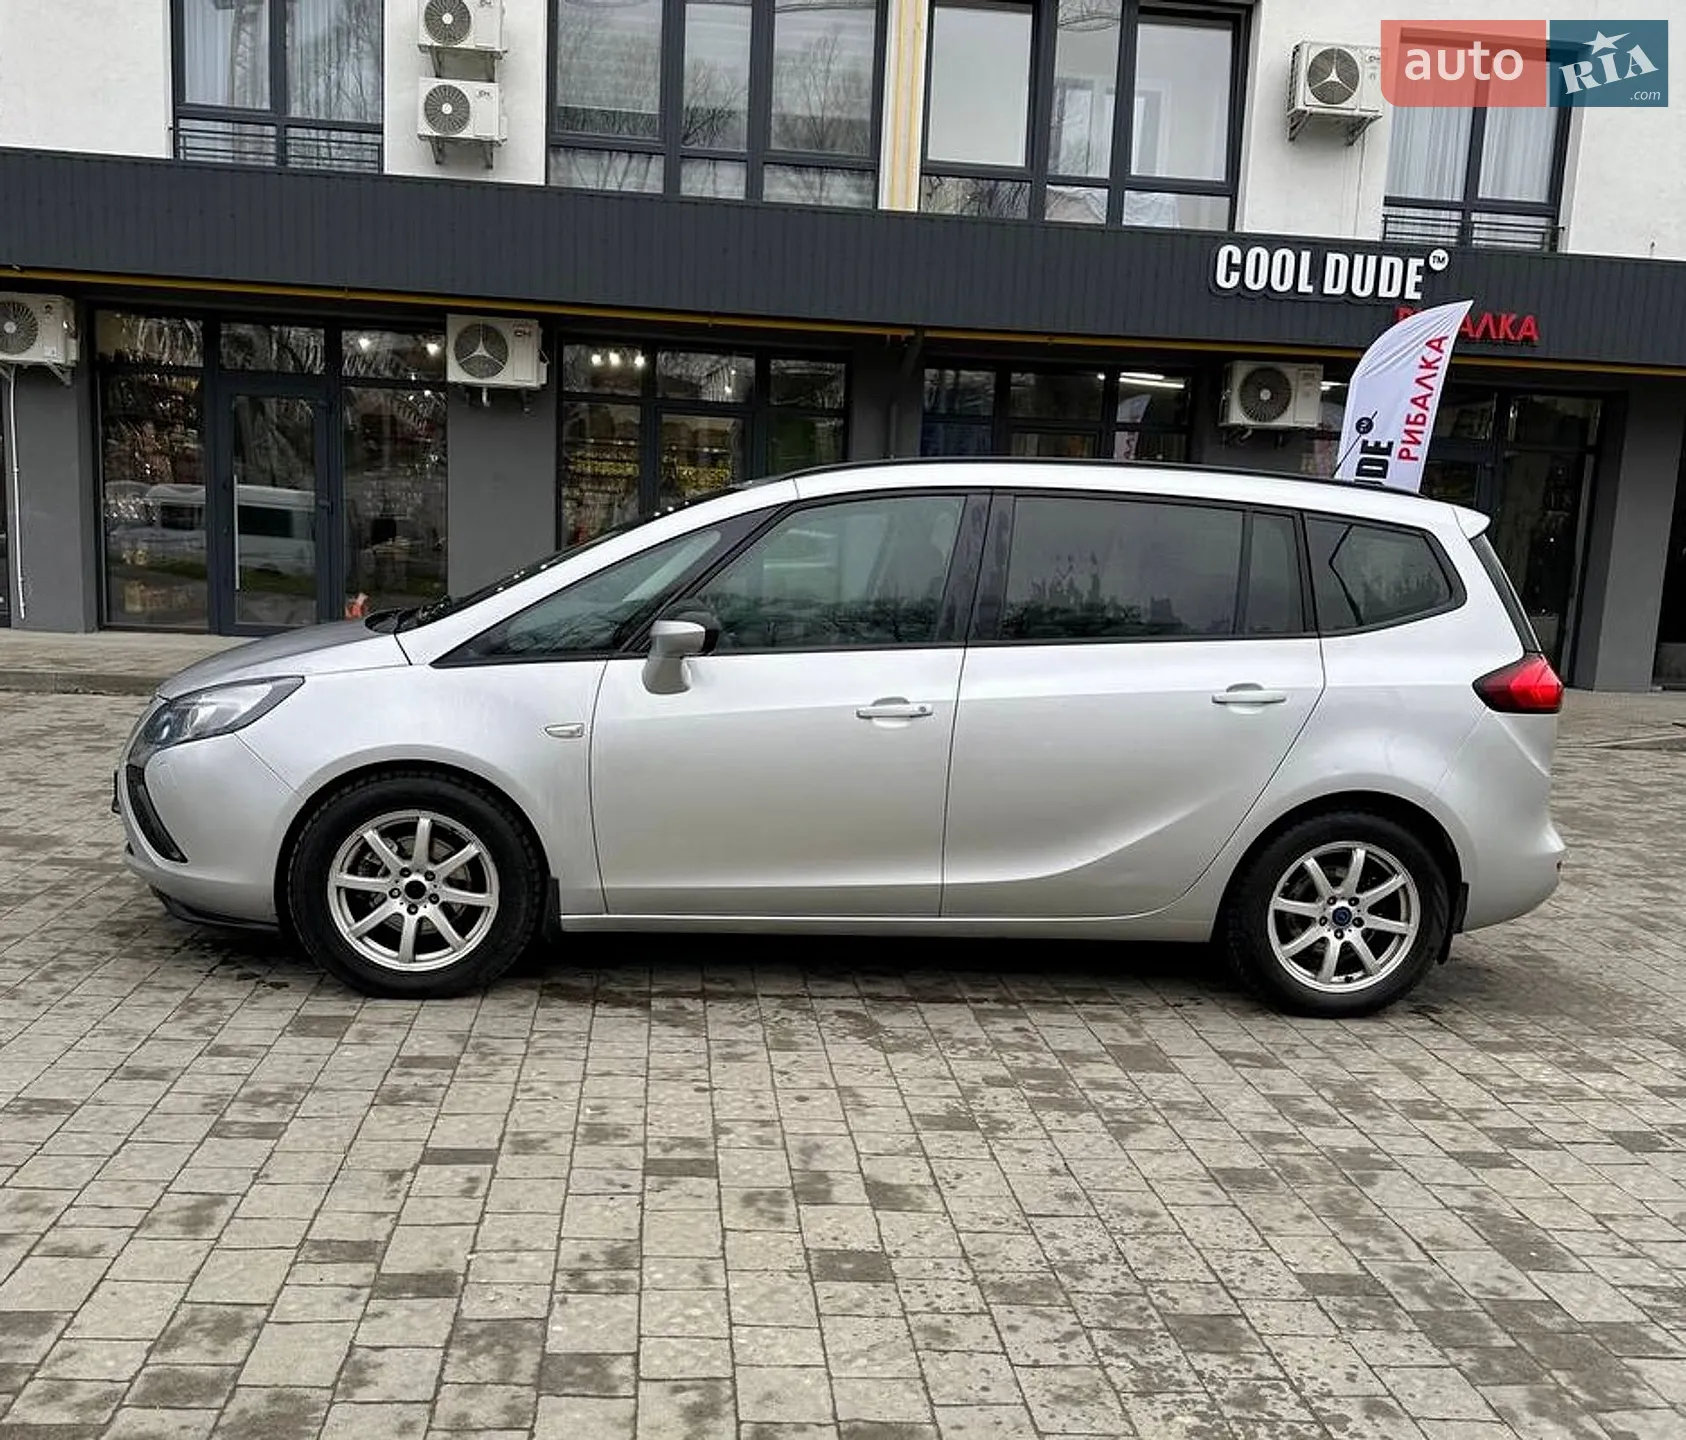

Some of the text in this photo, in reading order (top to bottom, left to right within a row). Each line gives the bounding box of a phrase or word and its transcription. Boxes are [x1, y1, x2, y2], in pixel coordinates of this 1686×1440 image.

[1216, 244, 1313, 293] COOL
[1323, 252, 1425, 300] DUDE
[1397, 335, 1449, 461] РИБАЛКА
